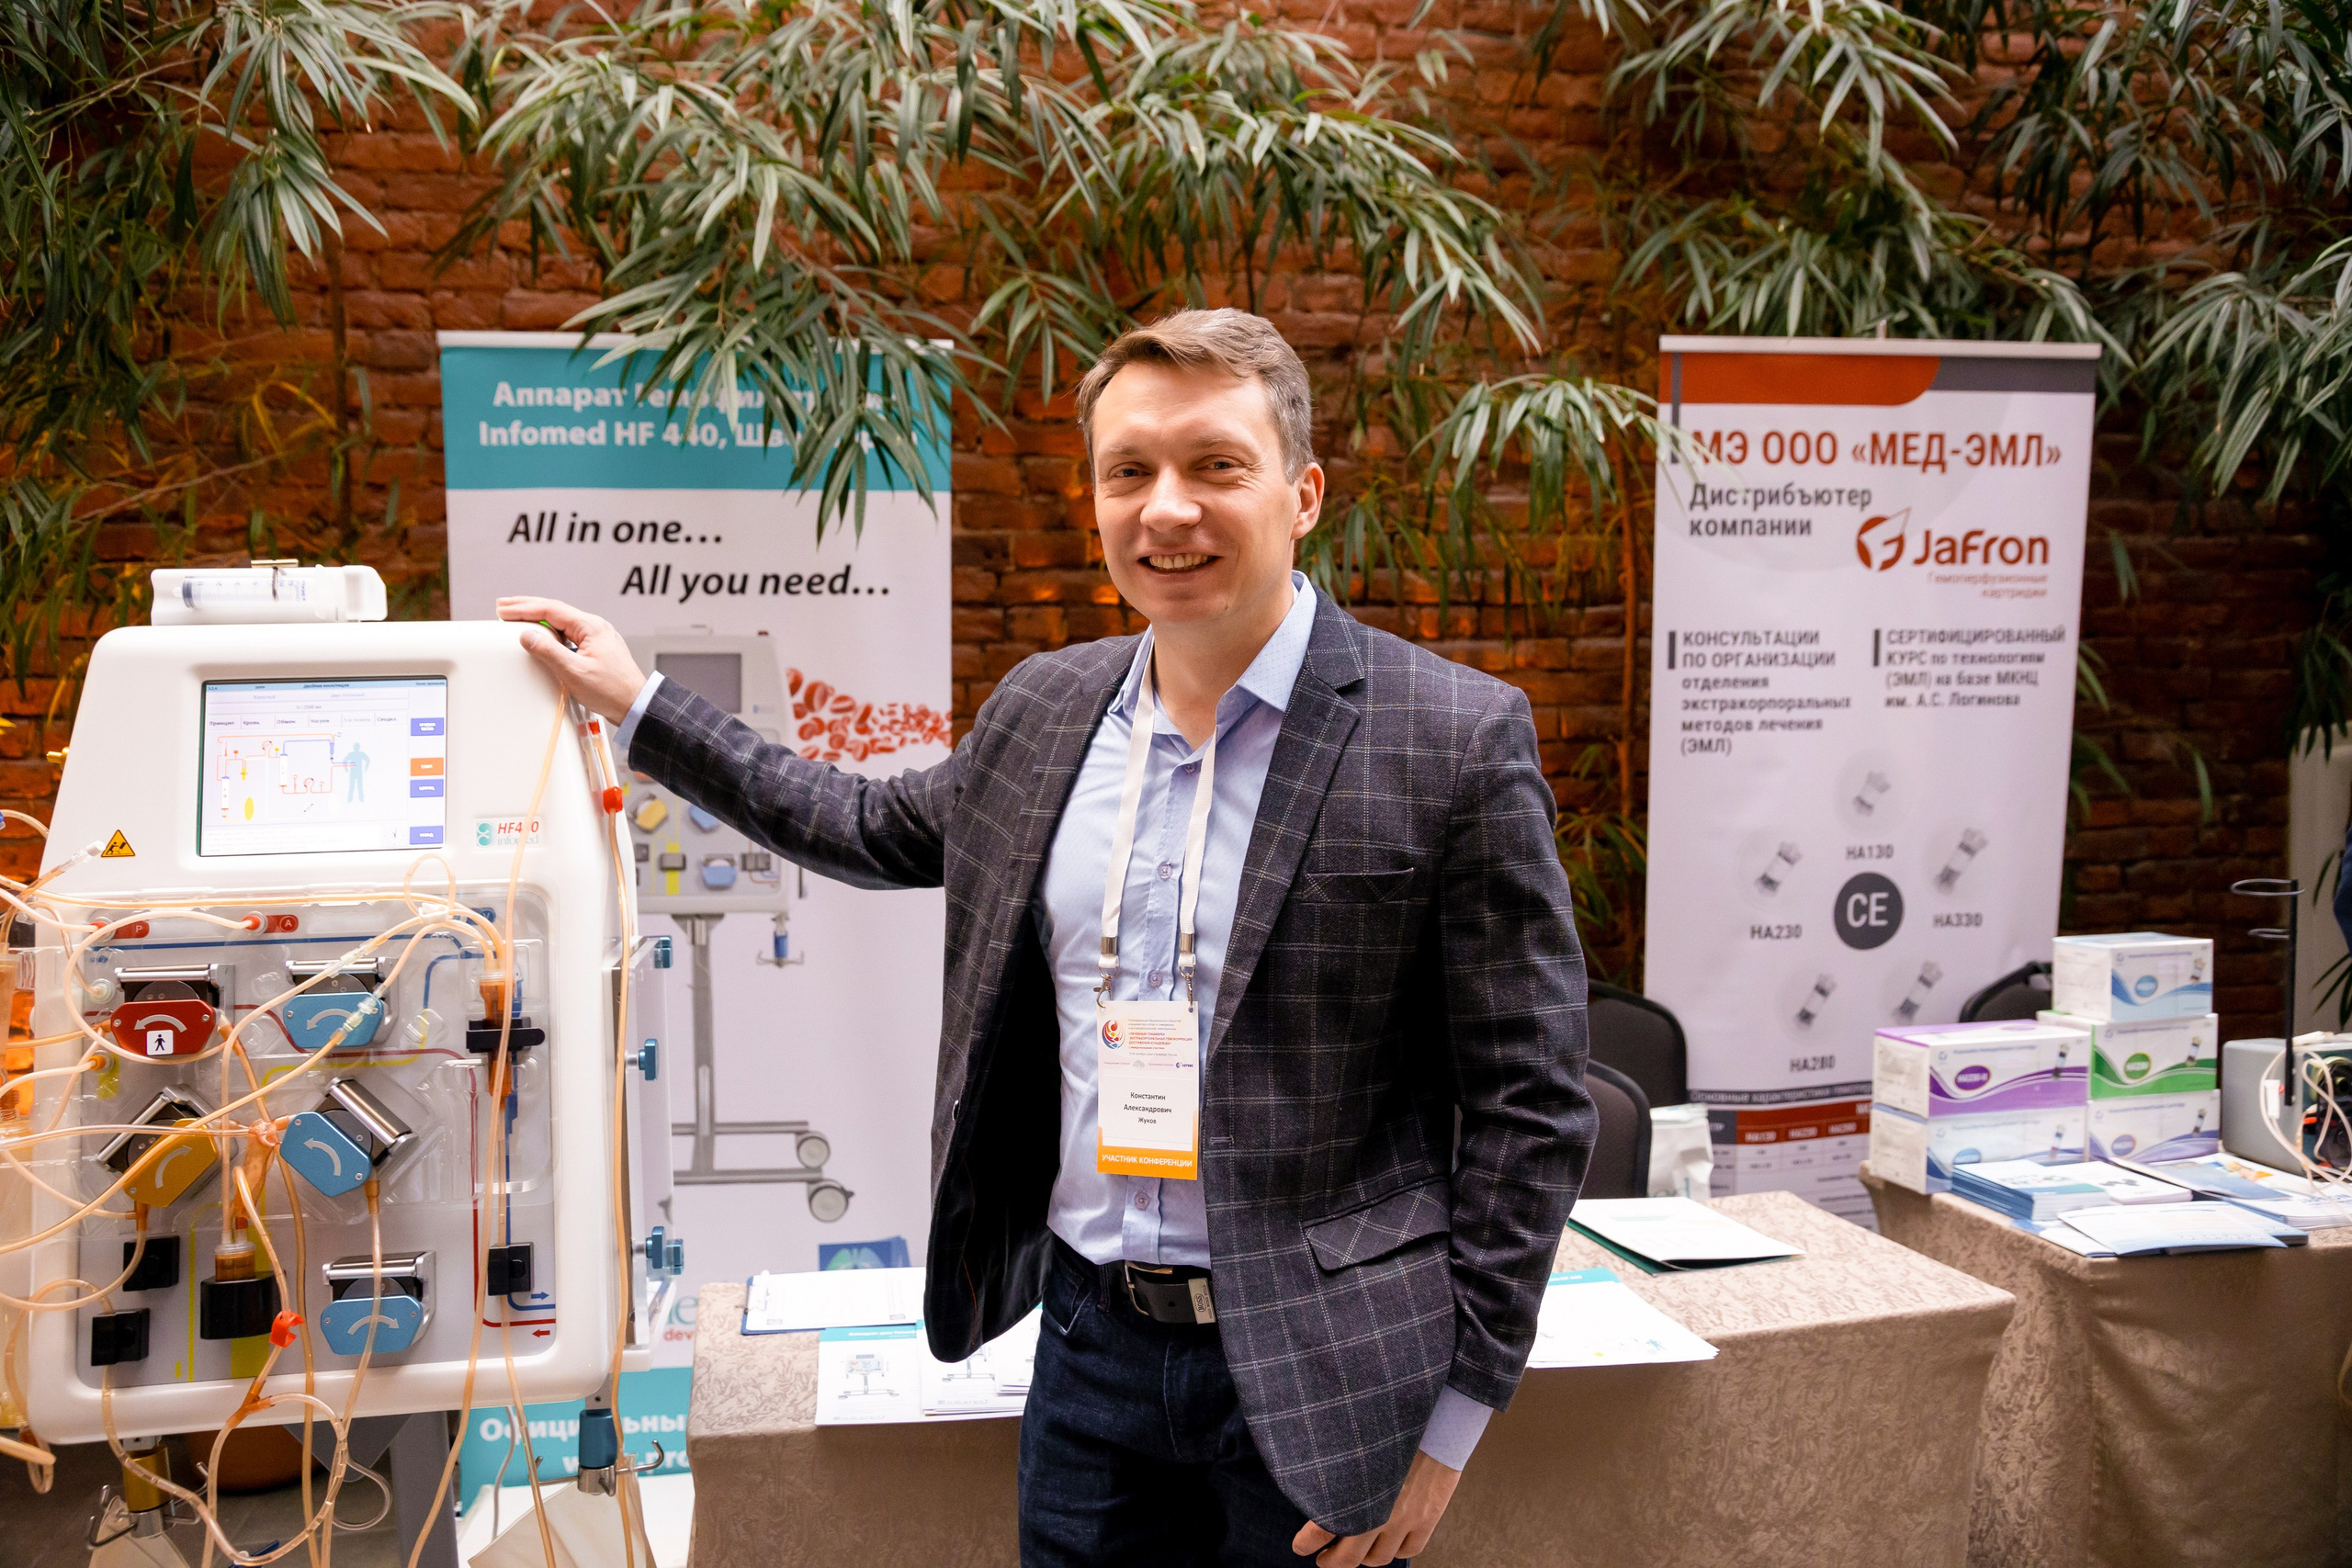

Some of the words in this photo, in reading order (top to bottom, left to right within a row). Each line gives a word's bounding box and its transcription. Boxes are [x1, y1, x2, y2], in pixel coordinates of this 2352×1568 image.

[492, 381, 628, 412] Аппарат
[479, 419, 606, 446] Infomed
[614, 421, 655, 446] HF
[1762, 431, 1838, 465] ООО
[1851, 432, 2062, 474] «МЕД-ЭМЛ»
[507, 512, 557, 543] All
[566, 513, 601, 543] in
[1689, 518, 1813, 537] компании
[620, 564, 672, 595] All
[678, 573, 749, 604] you
[1683, 630, 1821, 647] КОНСУЛЬТАЦИИ
[1886, 625, 2066, 646] СЕРТИФИЦИРОВАННЫЙ
[1682, 652, 1707, 668] ПО
[1711, 651, 1837, 668] ОРГАНИЗАЦИИ
[1886, 650, 1928, 665] КУРС
[1681, 677, 1770, 691] отделения
[1680, 719, 1753, 734] методов
[1680, 738, 1733, 757] (ЭМЛ)
[497, 821, 539, 834] HF40
[1847, 892, 1889, 928] CE
[135, 925, 143, 933] P
[285, 919, 292, 928] A
[1750, 924, 1803, 940] HA230
[1130, 1092, 1166, 1100] Константин
[1124, 1104, 1172, 1113] Александрович
[1102, 1155, 1138, 1164] УЧАСТНИК
[1138, 1156, 1193, 1167] КОНФЕРЕНЦИИ
